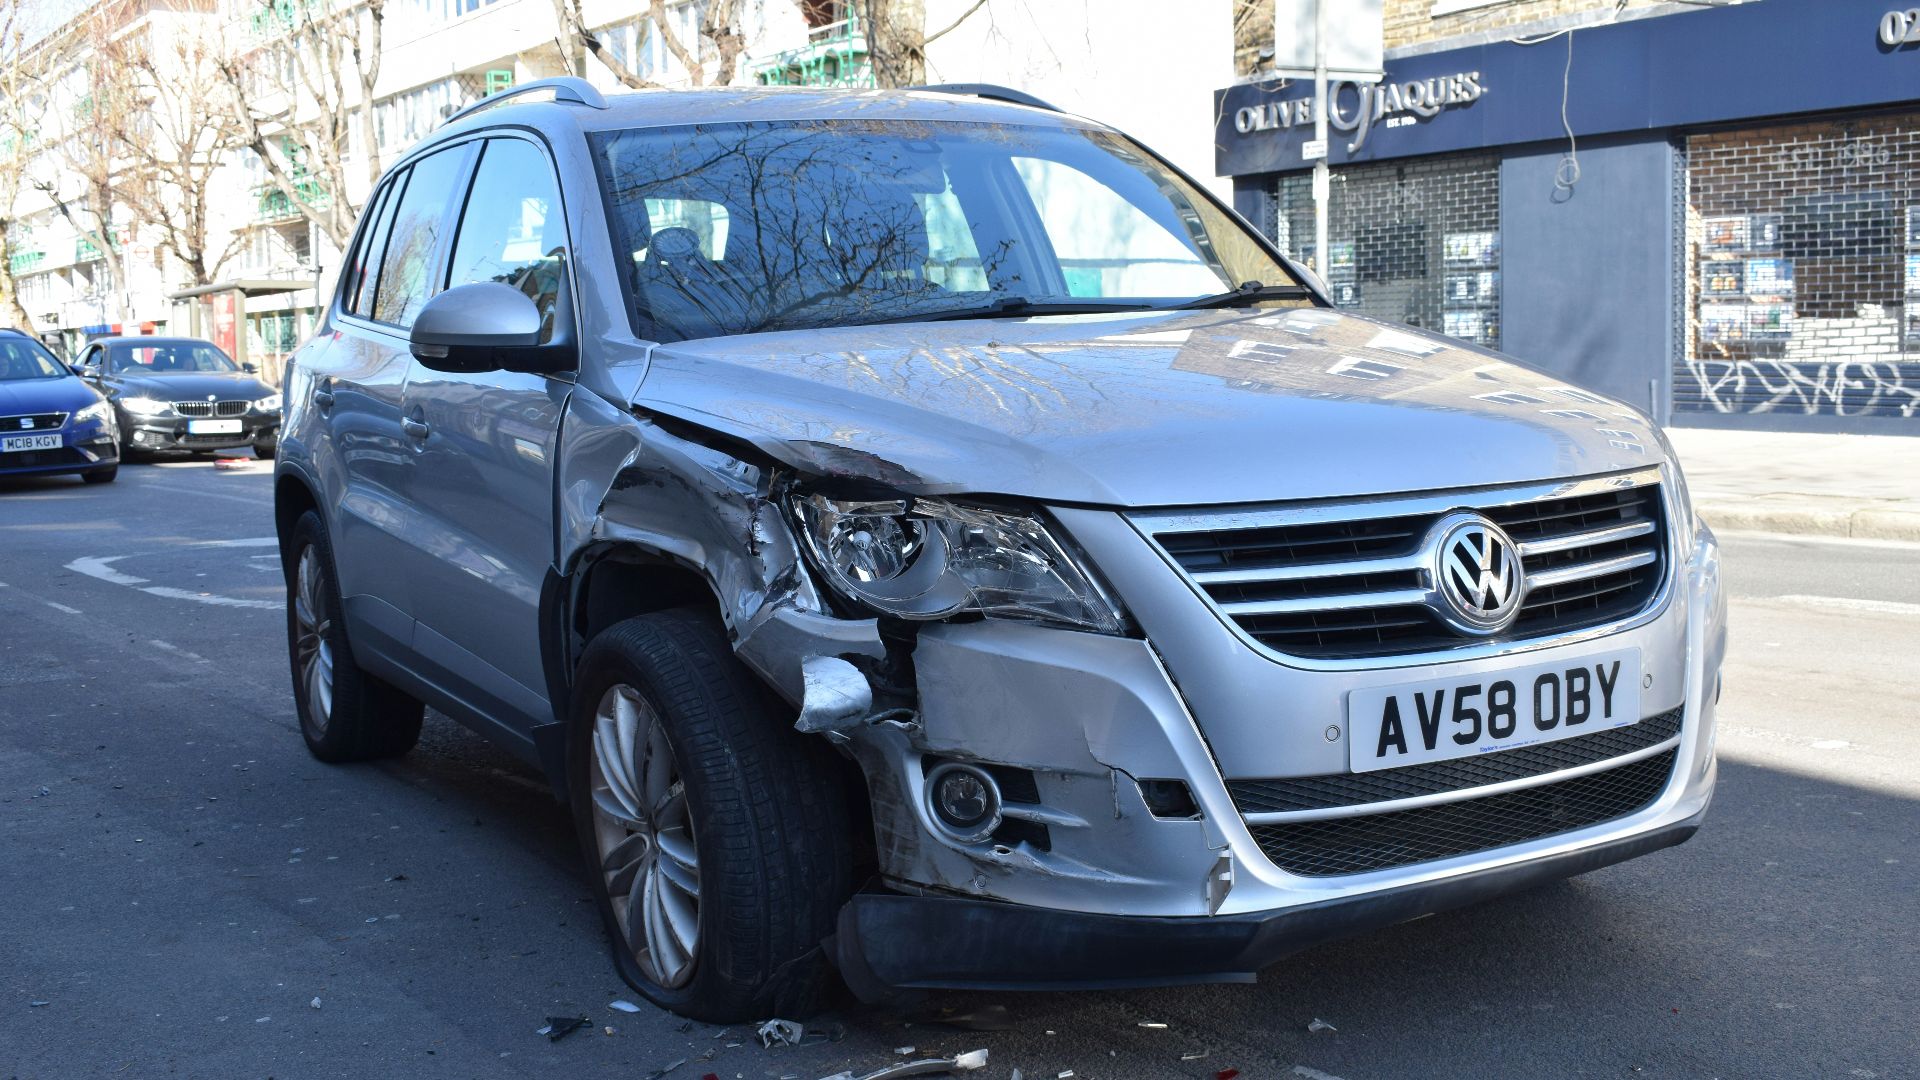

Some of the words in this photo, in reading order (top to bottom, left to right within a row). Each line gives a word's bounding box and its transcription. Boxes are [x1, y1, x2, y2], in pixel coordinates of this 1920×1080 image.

[1236, 97, 1317, 133] OLIVE
[1373, 72, 1480, 118] JAQUES
[7, 438, 33, 449] MC18
[35, 436, 57, 447] KGV
[1376, 680, 1516, 757] AV58
[1534, 660, 1621, 731] OBY
